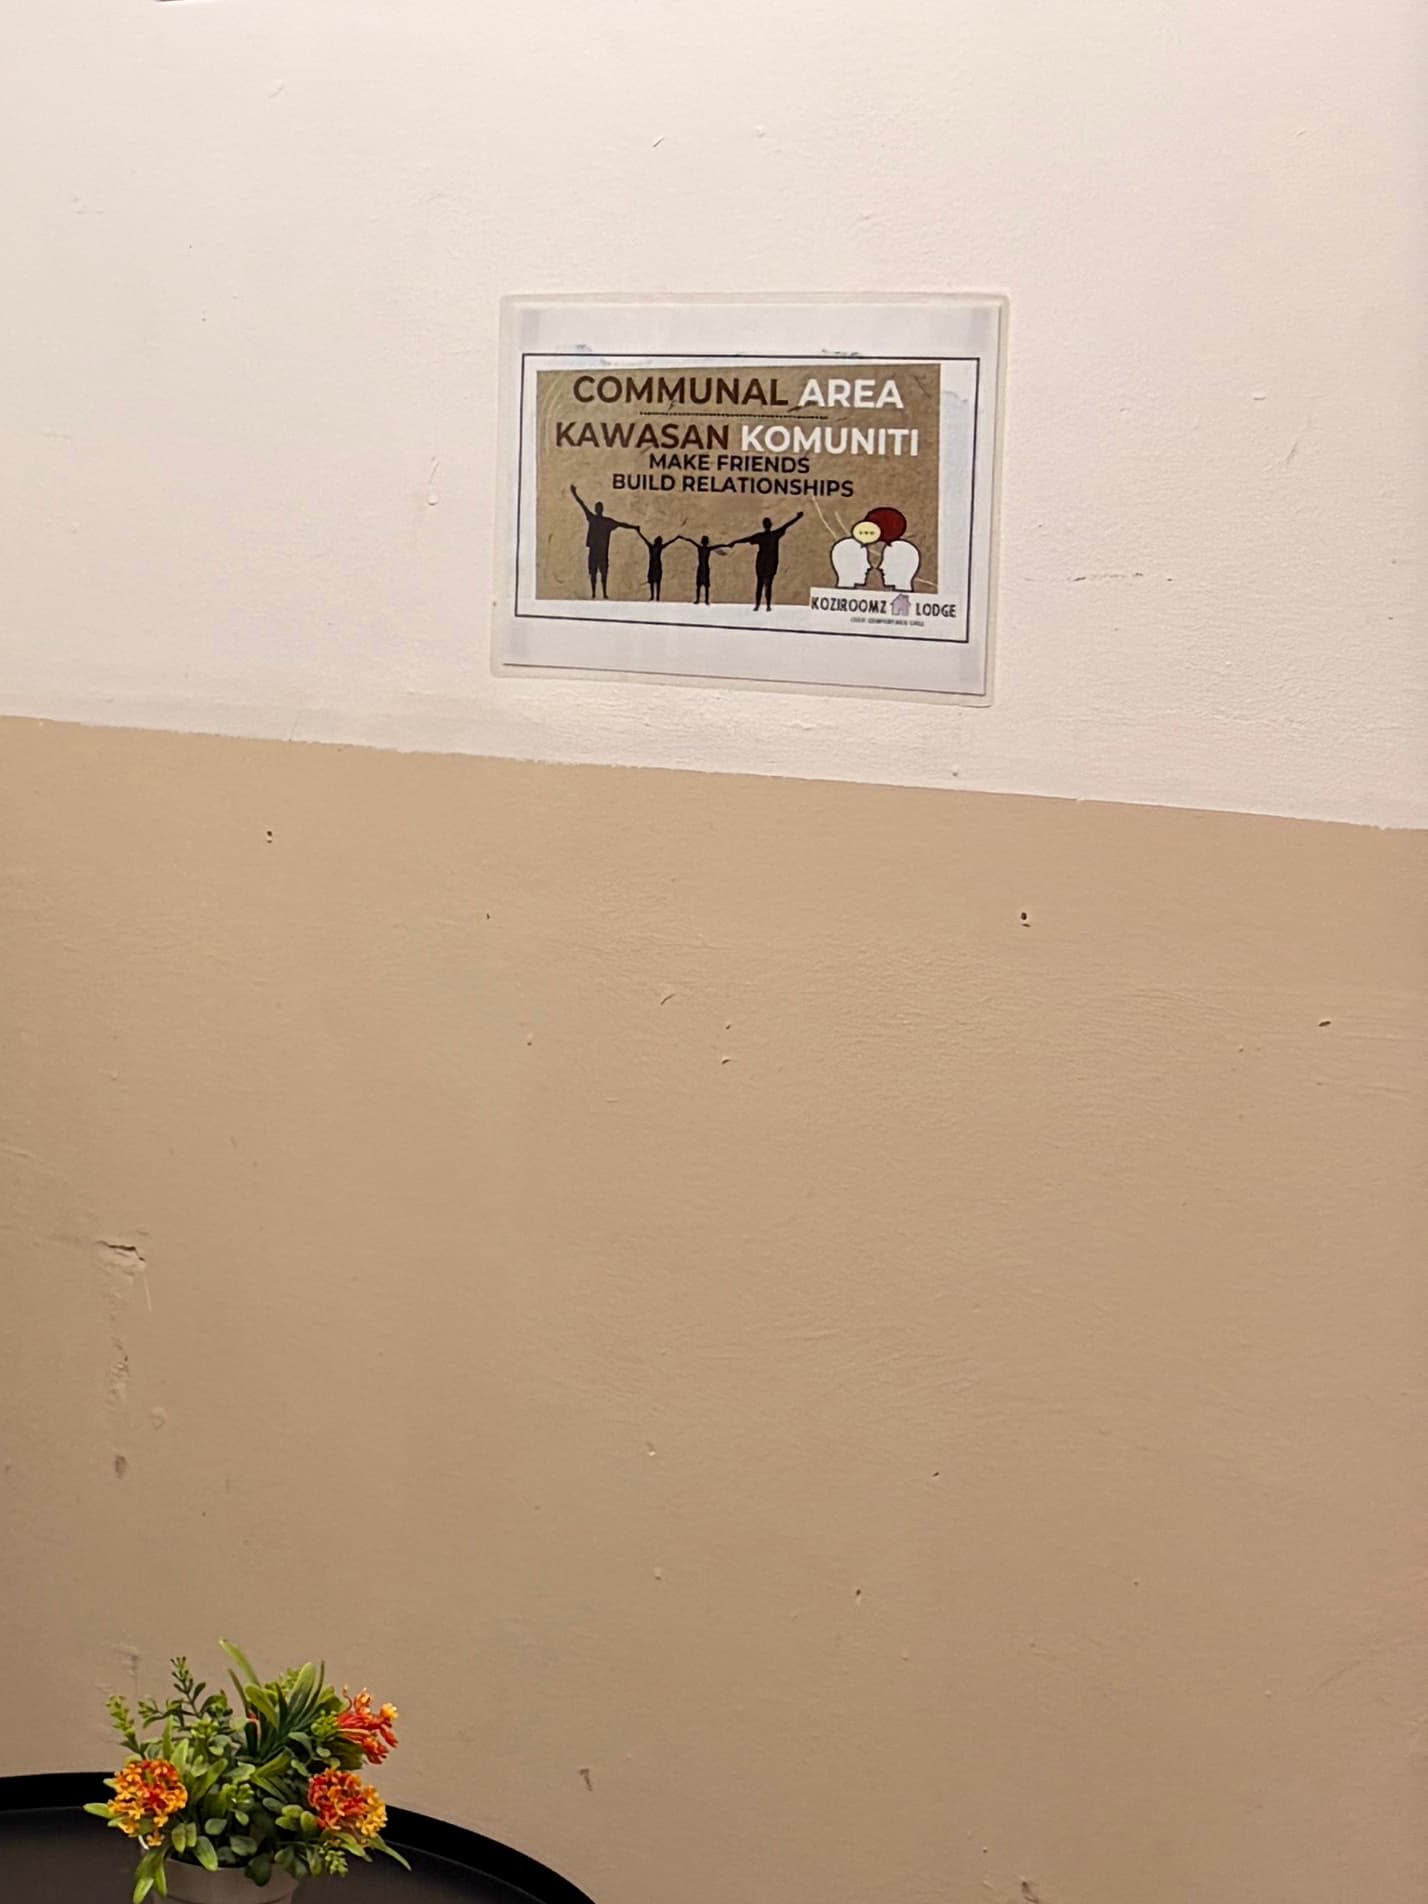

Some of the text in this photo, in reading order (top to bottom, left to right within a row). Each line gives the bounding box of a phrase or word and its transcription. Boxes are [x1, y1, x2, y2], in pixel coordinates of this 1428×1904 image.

[572, 376, 904, 409] COMMUNAL AREA
[555, 421, 919, 457] KAWASAN KOMUNITI
[648, 453, 810, 475] MAKE FRIENDS
[611, 473, 854, 498] BUILD RELATIONSHIPS
[811, 596, 957, 618] KOZIROOMZ LODGE
